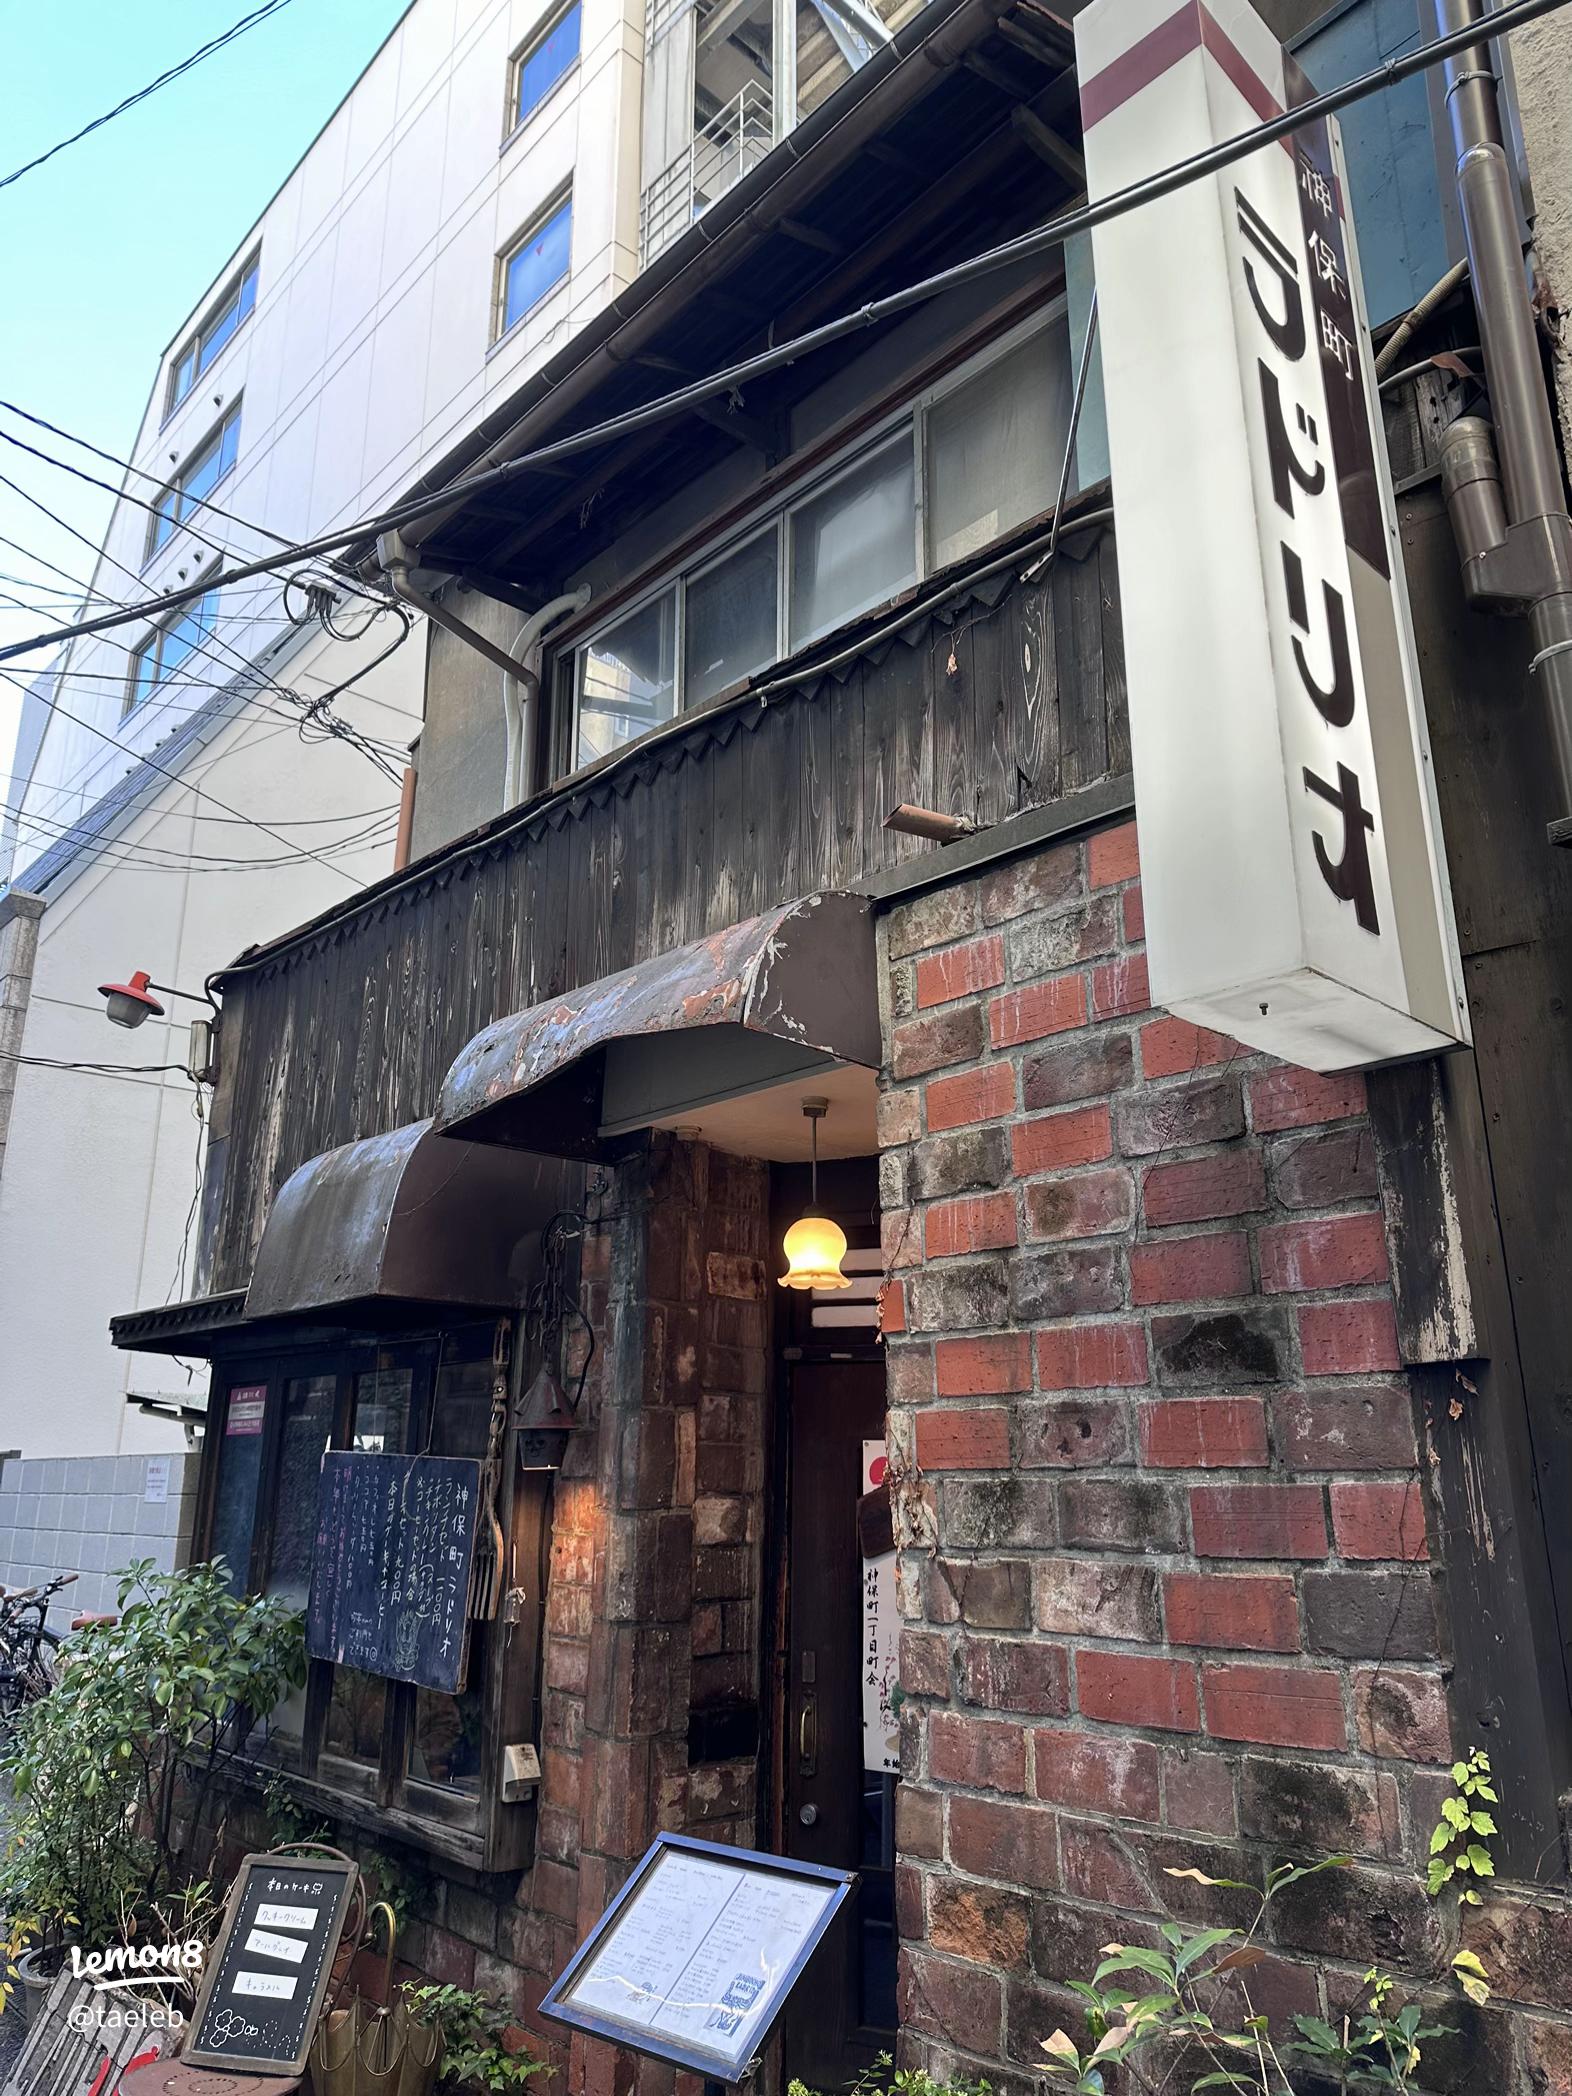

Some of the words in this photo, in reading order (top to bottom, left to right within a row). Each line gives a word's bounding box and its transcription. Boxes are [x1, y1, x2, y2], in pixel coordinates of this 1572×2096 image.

[1299, 150, 1354, 381] 神保町
[865, 1568, 880, 1686] 神保町一丁目町会
[267, 1877, 309, 1894] 本日のケーキ
